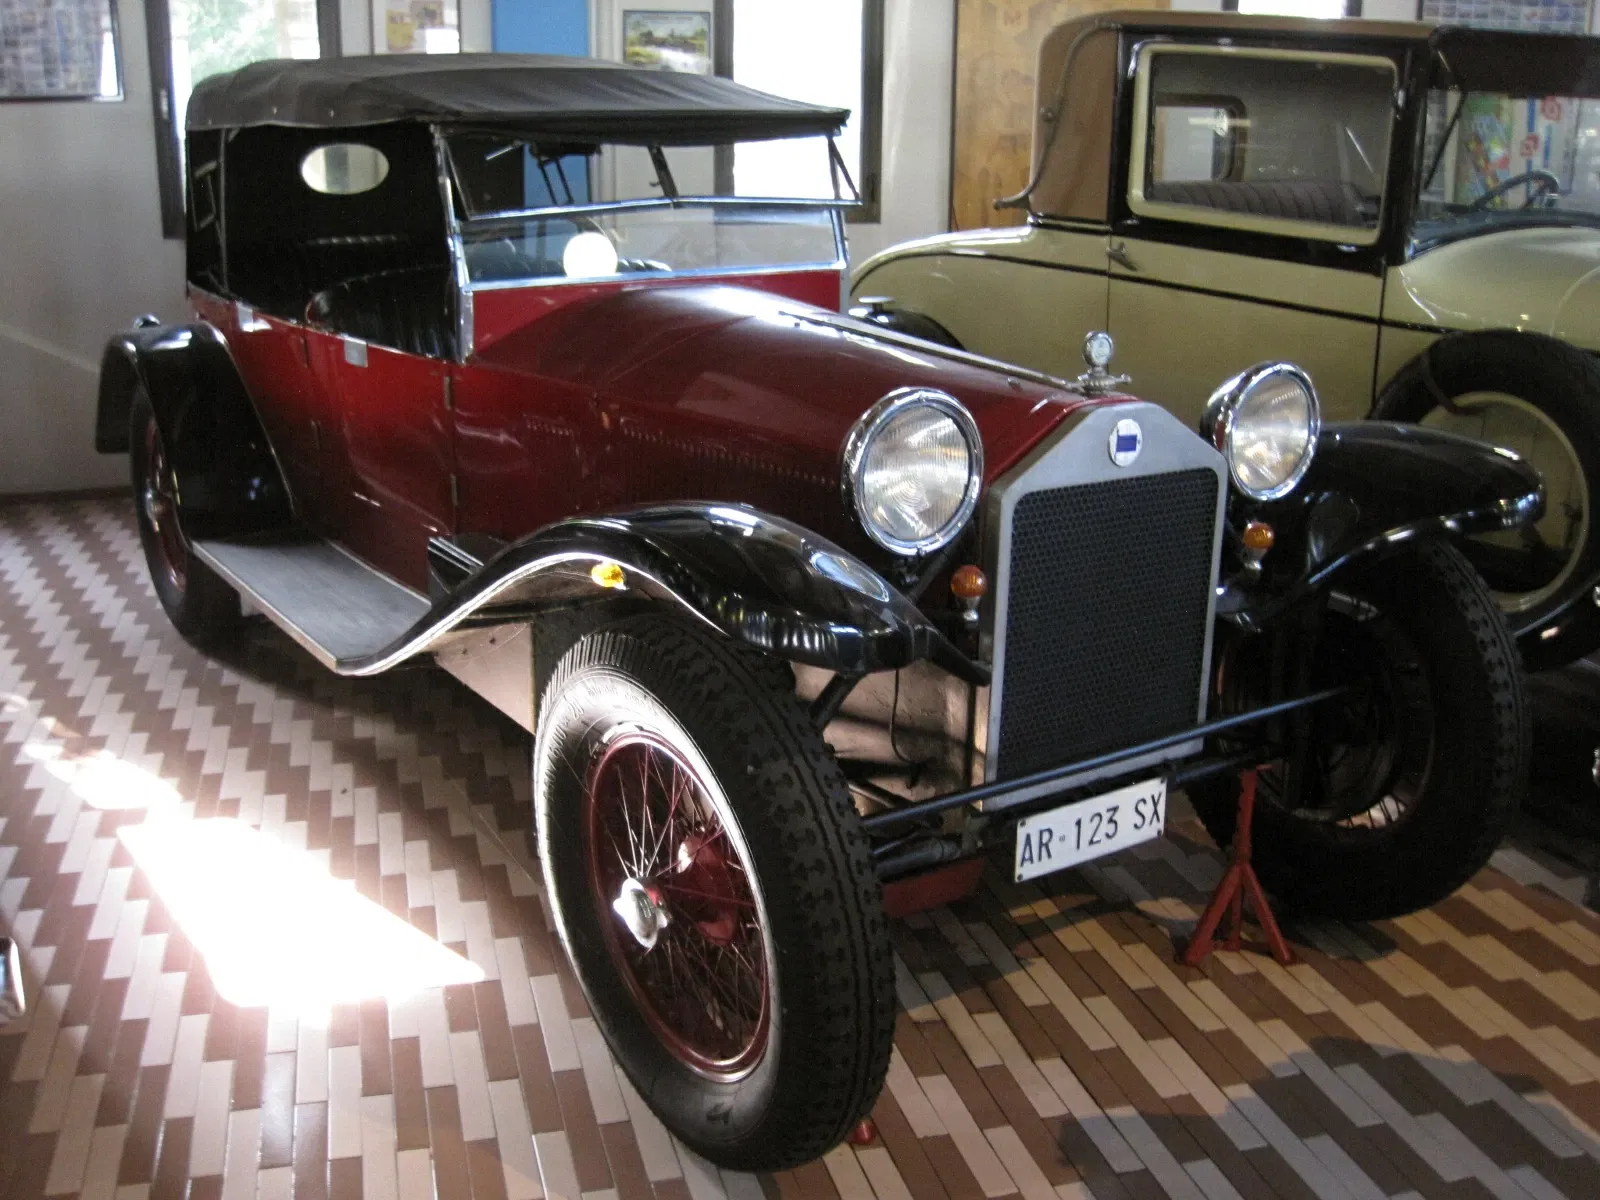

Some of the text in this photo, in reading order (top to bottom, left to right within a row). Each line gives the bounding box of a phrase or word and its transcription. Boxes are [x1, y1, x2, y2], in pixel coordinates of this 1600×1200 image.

[1020, 792, 1163, 868] AR 123 SX
